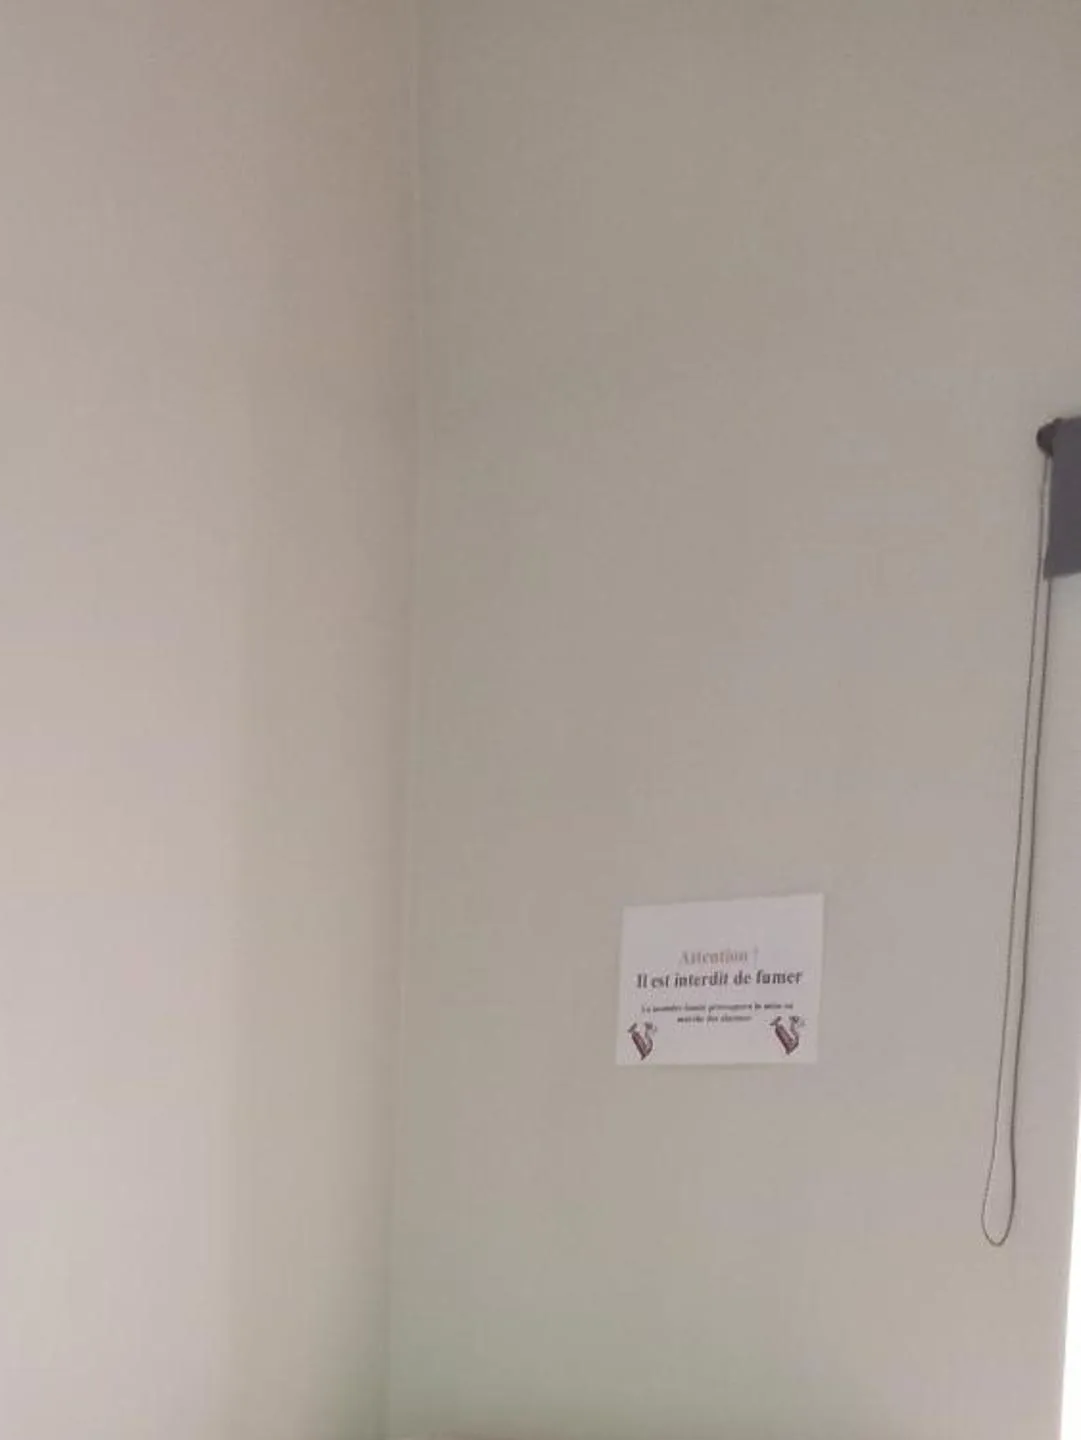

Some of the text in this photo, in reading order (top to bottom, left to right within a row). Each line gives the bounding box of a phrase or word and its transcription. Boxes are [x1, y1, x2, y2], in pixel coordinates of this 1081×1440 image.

[680, 947, 748, 965] Attention
[637, 970, 803, 989] Il est interdit de fumer
